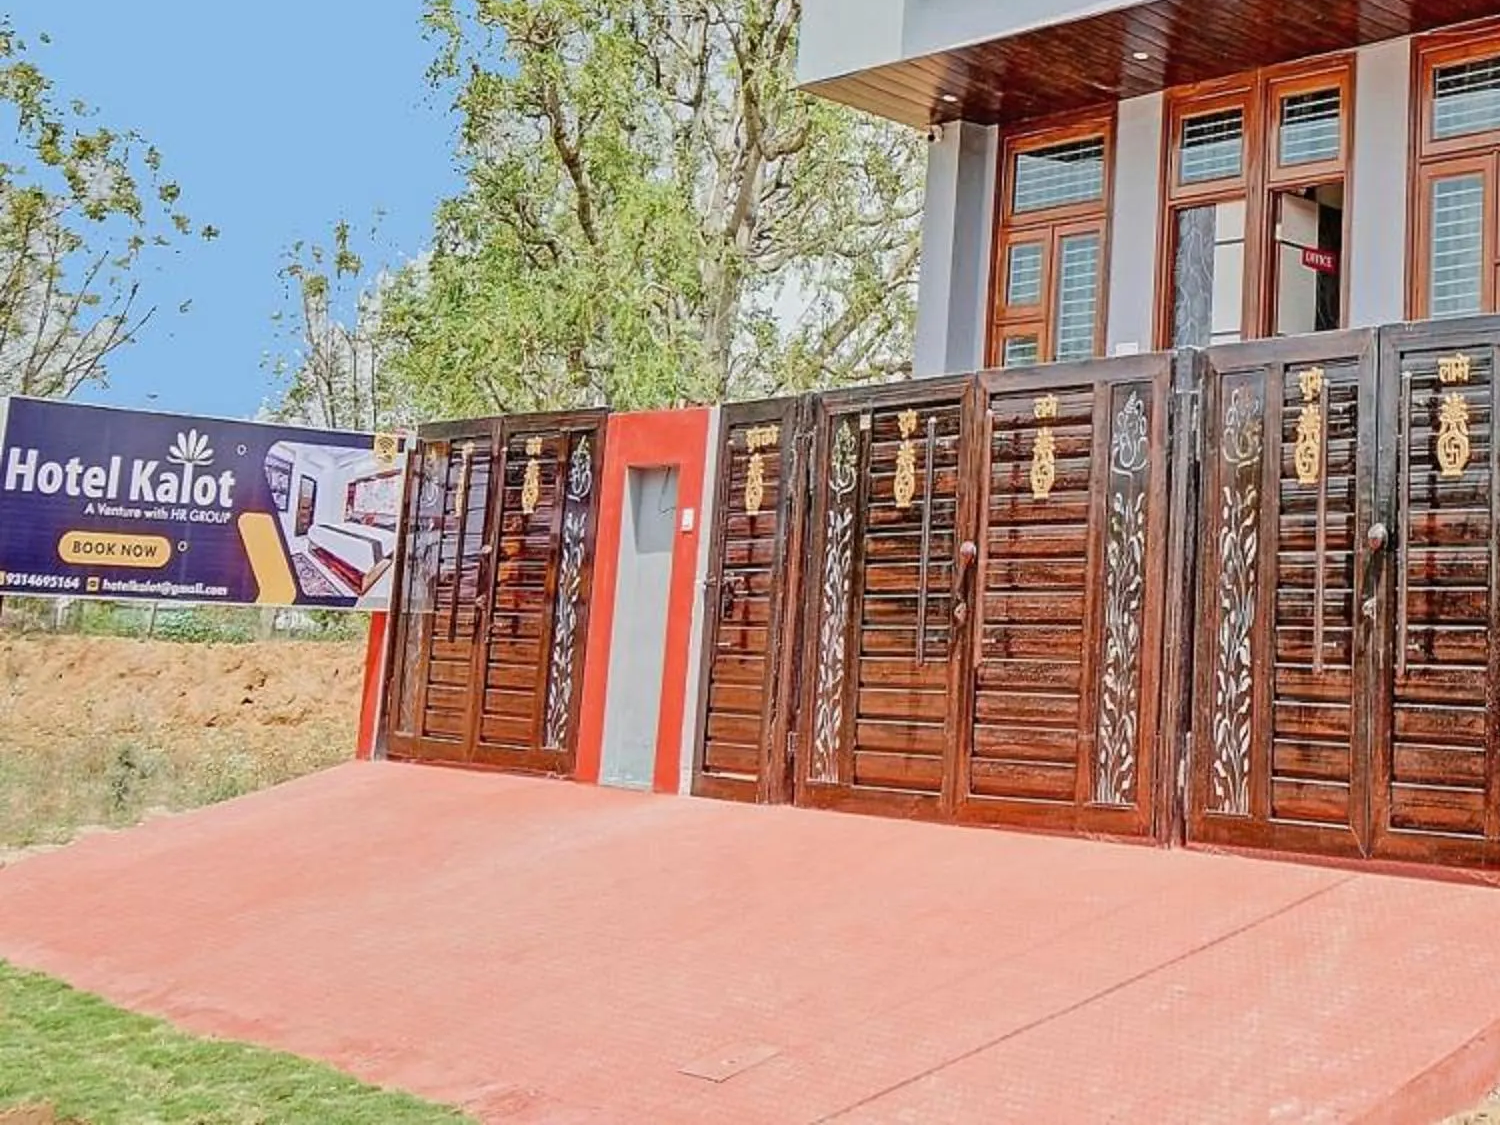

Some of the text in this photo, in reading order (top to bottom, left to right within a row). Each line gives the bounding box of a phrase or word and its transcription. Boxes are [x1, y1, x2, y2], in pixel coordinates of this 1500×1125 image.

[4, 446, 236, 508] Hotel Kalot
[84, 503, 232, 524] A Venture with HR GROUP
[72, 540, 157, 557] BOOK NOW
